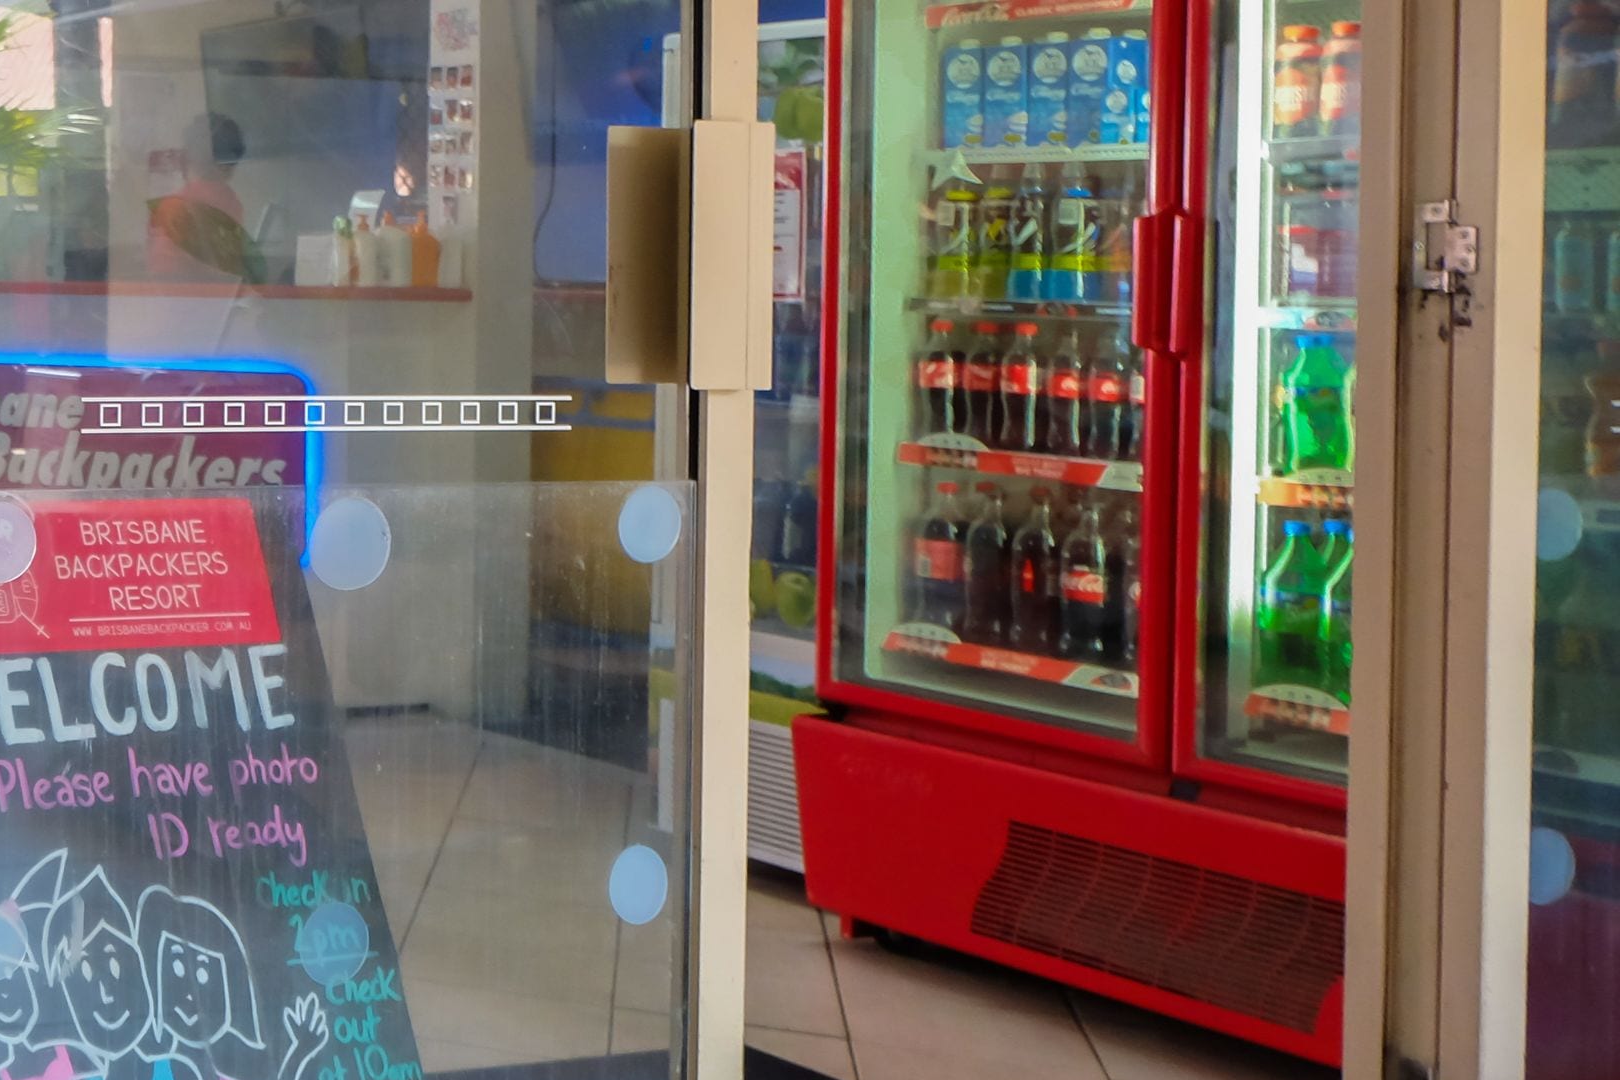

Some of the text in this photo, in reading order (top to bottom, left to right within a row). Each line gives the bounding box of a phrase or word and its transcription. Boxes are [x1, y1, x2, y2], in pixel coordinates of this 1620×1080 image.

[80, 519, 207, 546] BRISBANE
[54, 551, 228, 580] BACKPACKERS
[108, 584, 202, 611] RESORT
[128, 746, 213, 799] have
[232, 743, 318, 800] photo
[148, 804, 307, 868] ID ready
[334, 1006, 381, 1043] out
